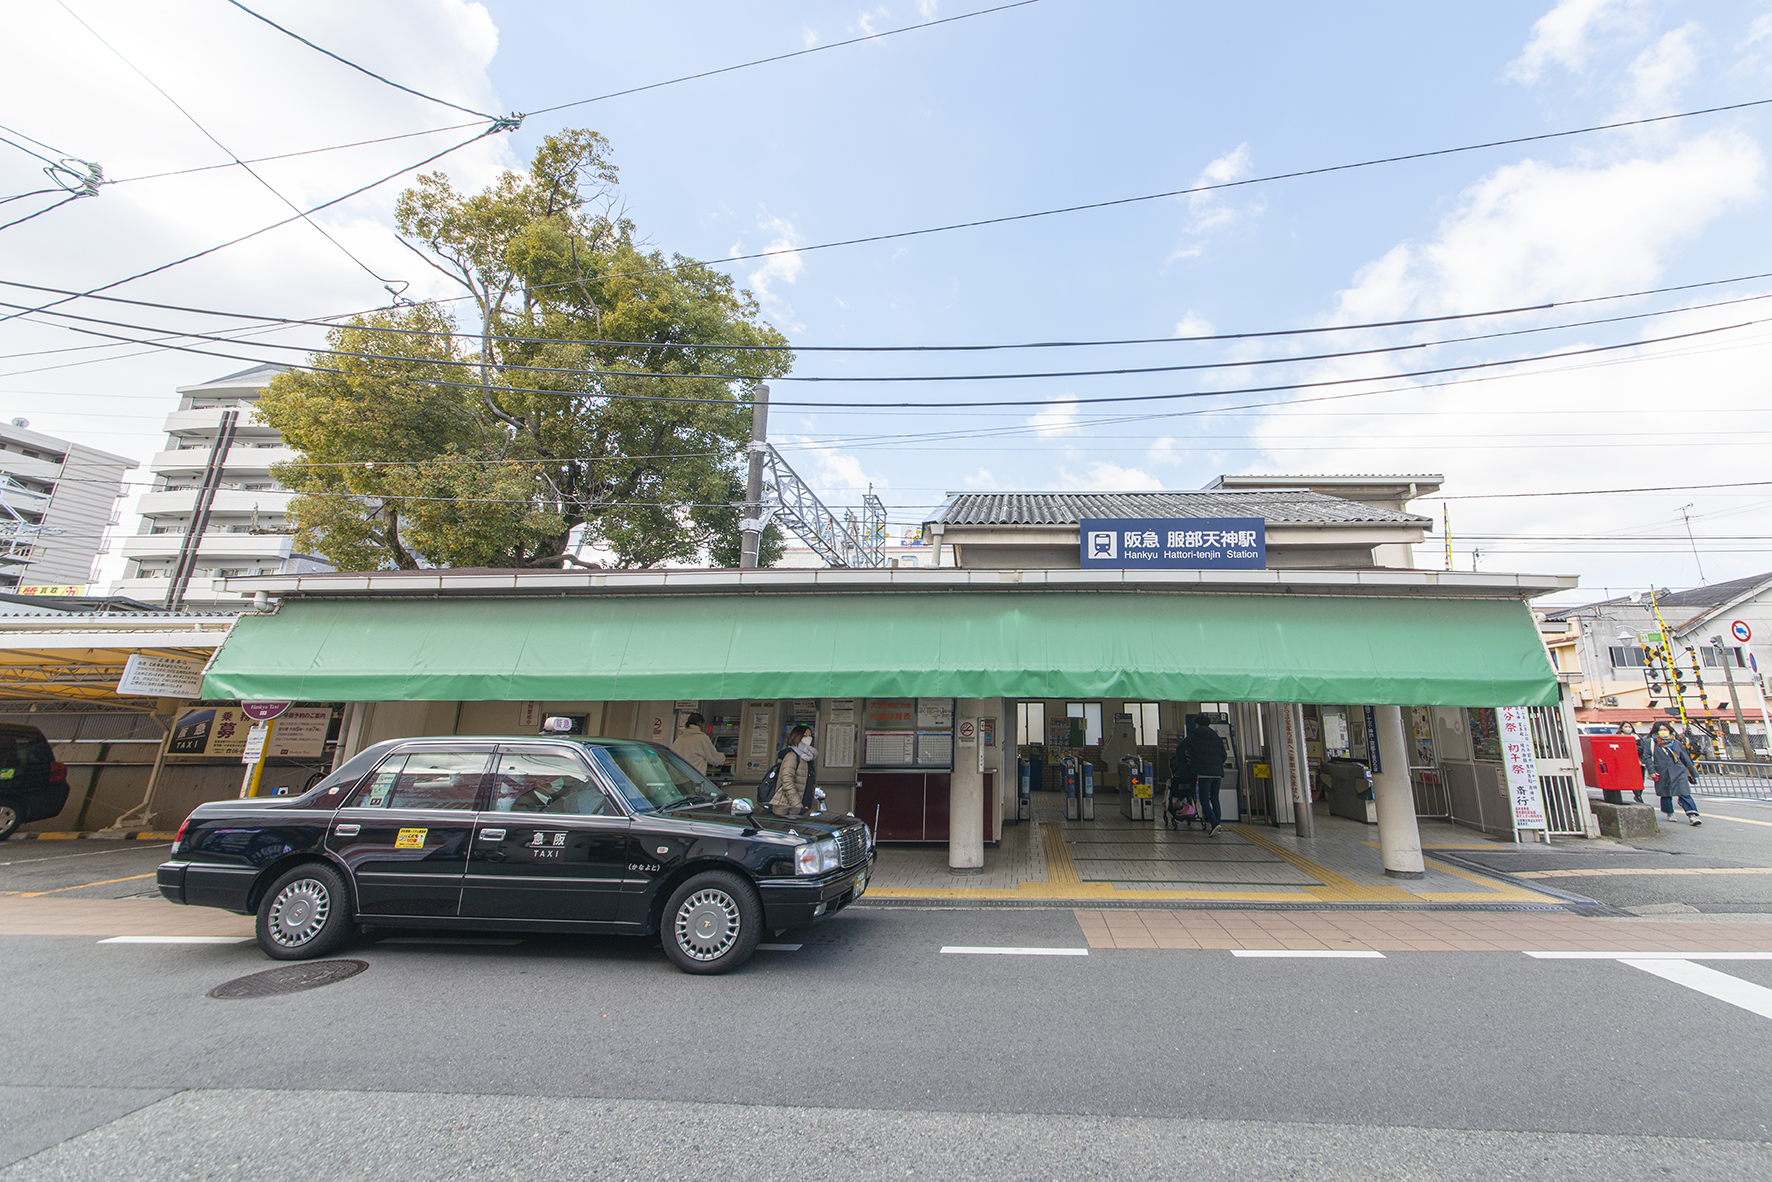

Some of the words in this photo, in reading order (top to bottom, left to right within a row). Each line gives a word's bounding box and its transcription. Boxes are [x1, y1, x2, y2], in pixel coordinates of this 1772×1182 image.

[1124, 530, 1160, 548] 阪急
[1166, 530, 1257, 548] 服部天神駅
[1124, 550, 1158, 561] Hankyu
[1164, 550, 1221, 560] Hattori-tenjin
[1227, 550, 1258, 559] Station
[556, 719, 571, 729] 阪急
[176, 740, 199, 749] TAXI
[1508, 743, 1525, 774] 初午祭
[533, 850, 559, 858] TAXI
[628, 863, 661, 872] (かなよと)
